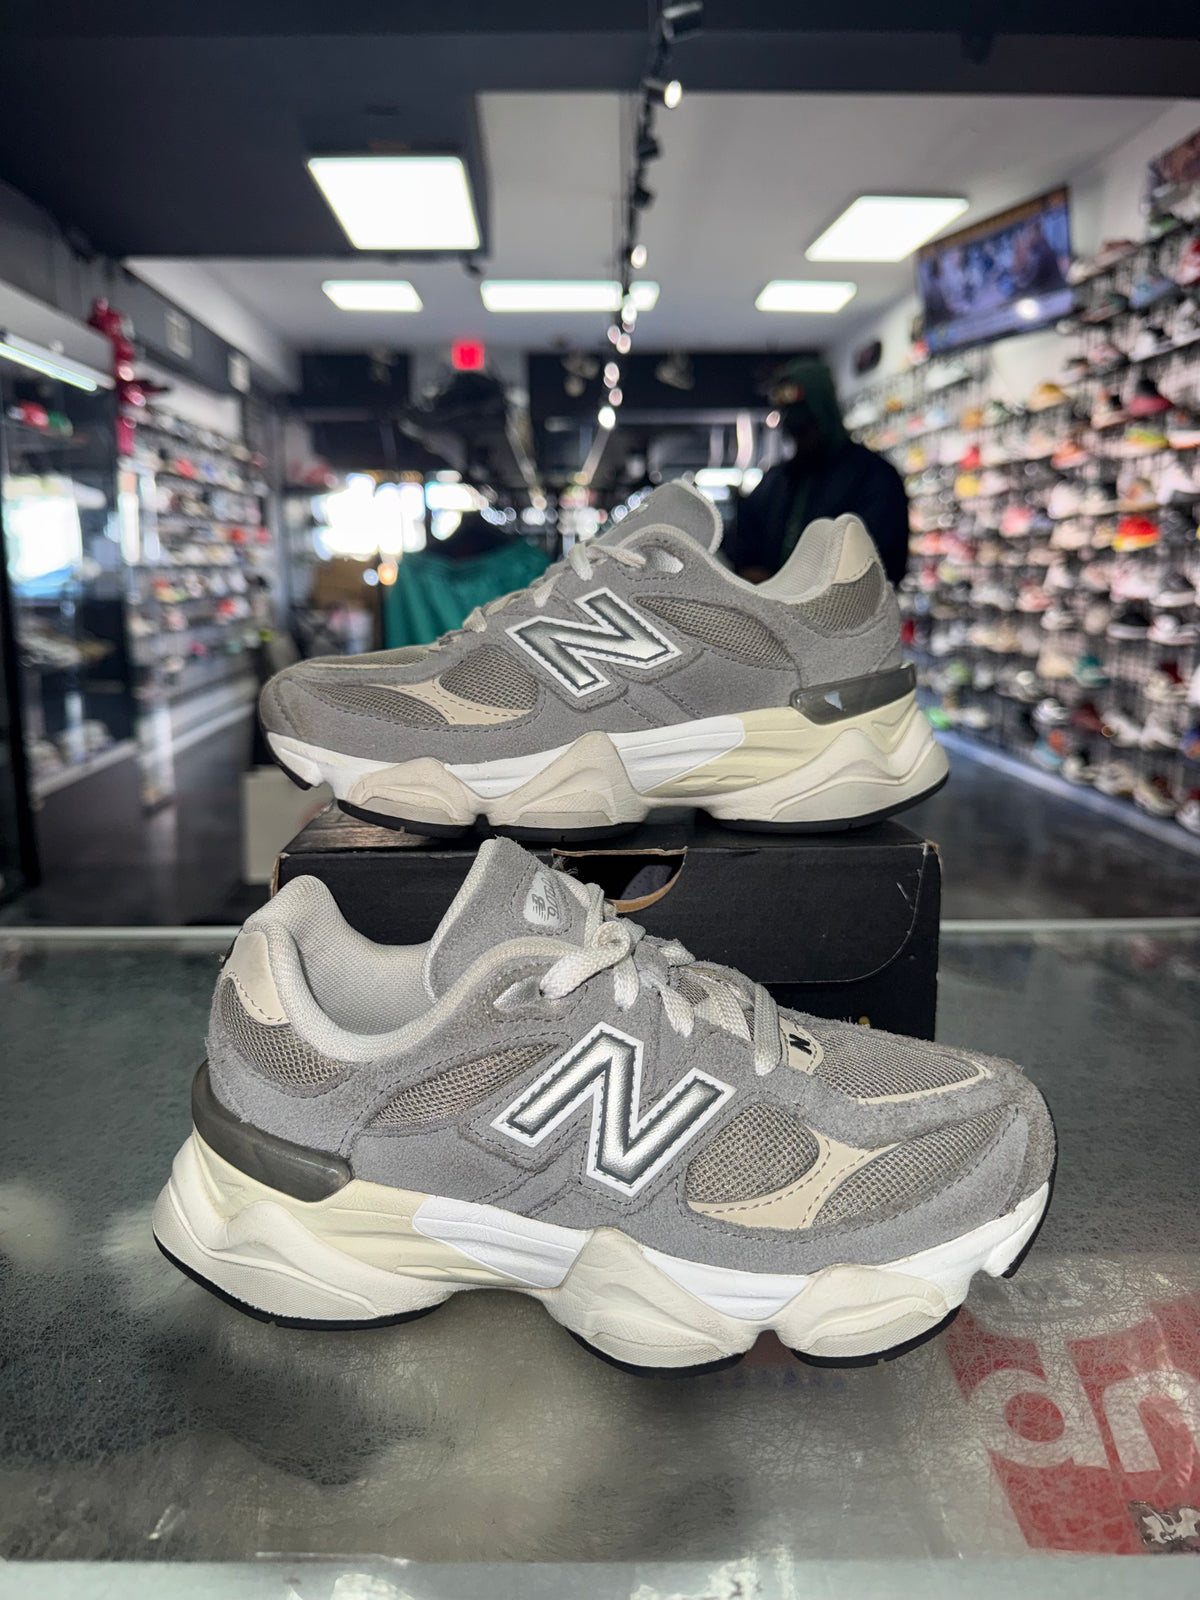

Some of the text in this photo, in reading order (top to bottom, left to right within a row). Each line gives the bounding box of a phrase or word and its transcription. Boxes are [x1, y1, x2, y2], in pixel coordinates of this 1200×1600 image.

[505, 587, 683, 698] N
[789, 1033, 812, 1055] N
[490, 1021, 737, 1197] N
